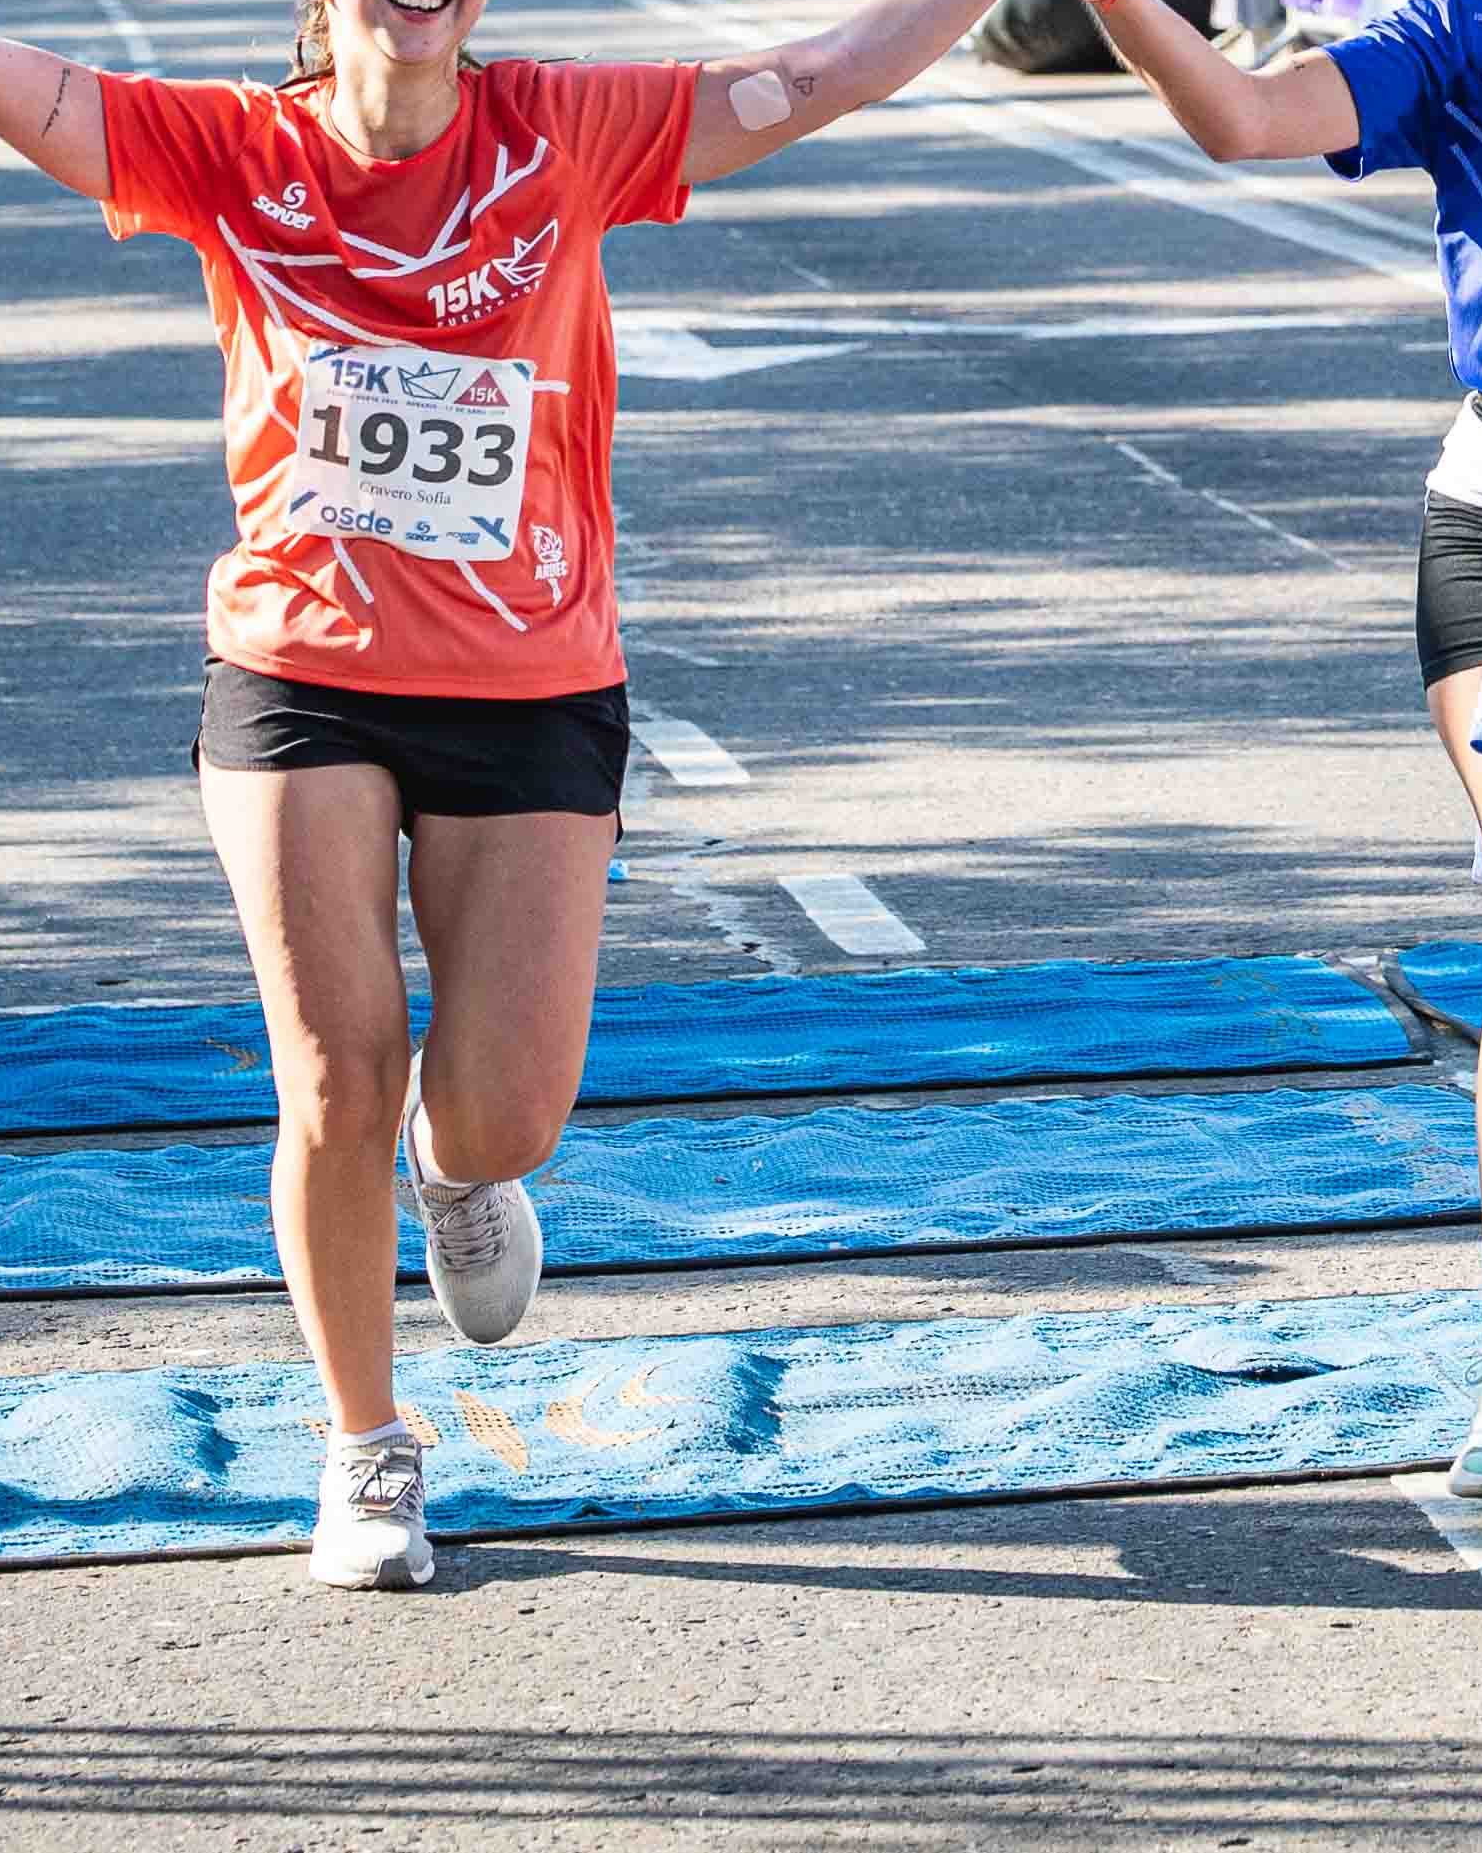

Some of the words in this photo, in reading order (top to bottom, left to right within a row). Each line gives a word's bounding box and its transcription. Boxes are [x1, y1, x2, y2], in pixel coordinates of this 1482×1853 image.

[427, 262, 501, 320] 15K
[329, 358, 391, 394] 15K
[468, 387, 498, 403] 15K
[308, 404, 516, 487] 1933
[359, 480, 413, 502] Cravero
[320, 505, 394, 535] osde
